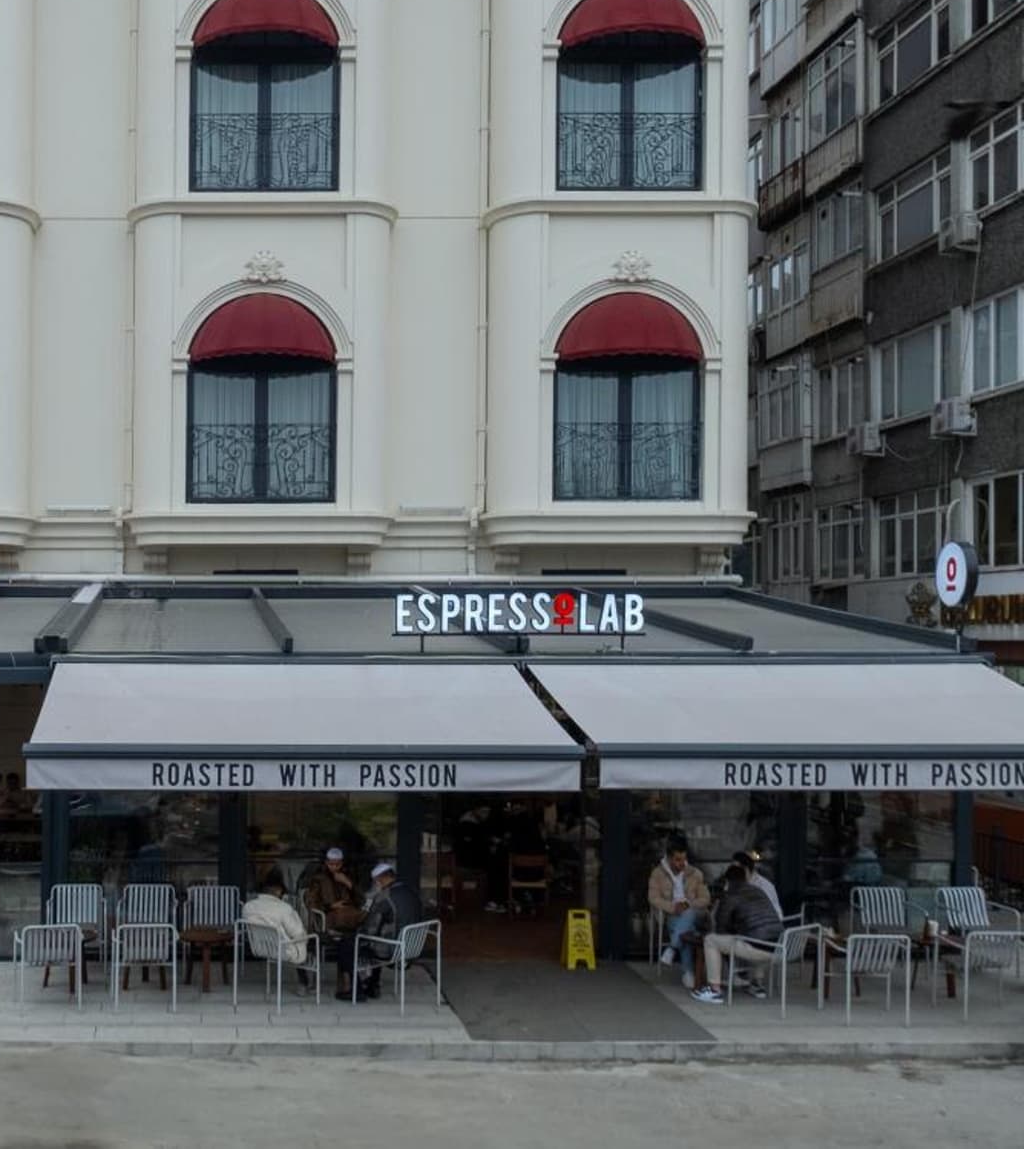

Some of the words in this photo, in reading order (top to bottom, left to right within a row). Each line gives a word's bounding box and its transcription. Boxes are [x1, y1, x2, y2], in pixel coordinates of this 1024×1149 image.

[152, 762, 255, 787] ROASTED
[279, 763, 336, 787] WITH
[360, 763, 458, 787] PASSION
[725, 762, 827, 787] ROASTED
[851, 762, 908, 787] WITH
[931, 762, 1024, 787] PASSION
